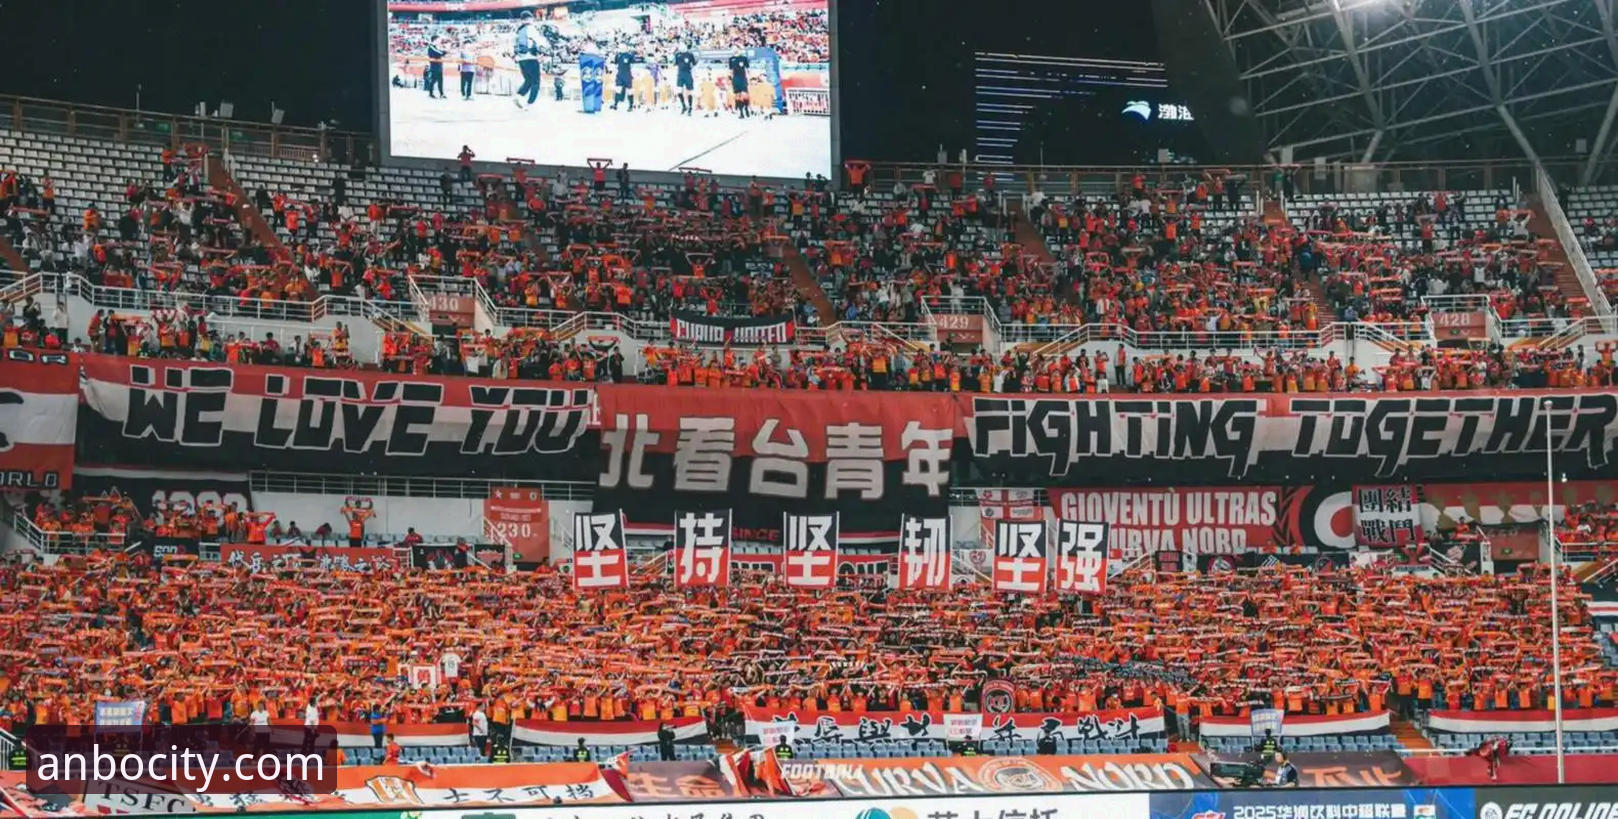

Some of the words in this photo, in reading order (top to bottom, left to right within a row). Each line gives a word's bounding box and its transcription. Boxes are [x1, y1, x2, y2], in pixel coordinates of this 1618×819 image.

[1439, 312, 1470, 327] 428
[122, 364, 234, 446] WE
[253, 374, 444, 456] LOVE
[460, 383, 594, 454] YOU
[973, 396, 1262, 477] FIGHTING
[1288, 394, 1618, 477] TOGETHER
[600, 413, 953, 500] 北看台青年
[1186, 491, 1278, 527] ULTRAS
[1108, 527, 1178, 556] URVA
[1181, 527, 1248, 555] NORD
[1060, 761, 1194, 792] NORD
